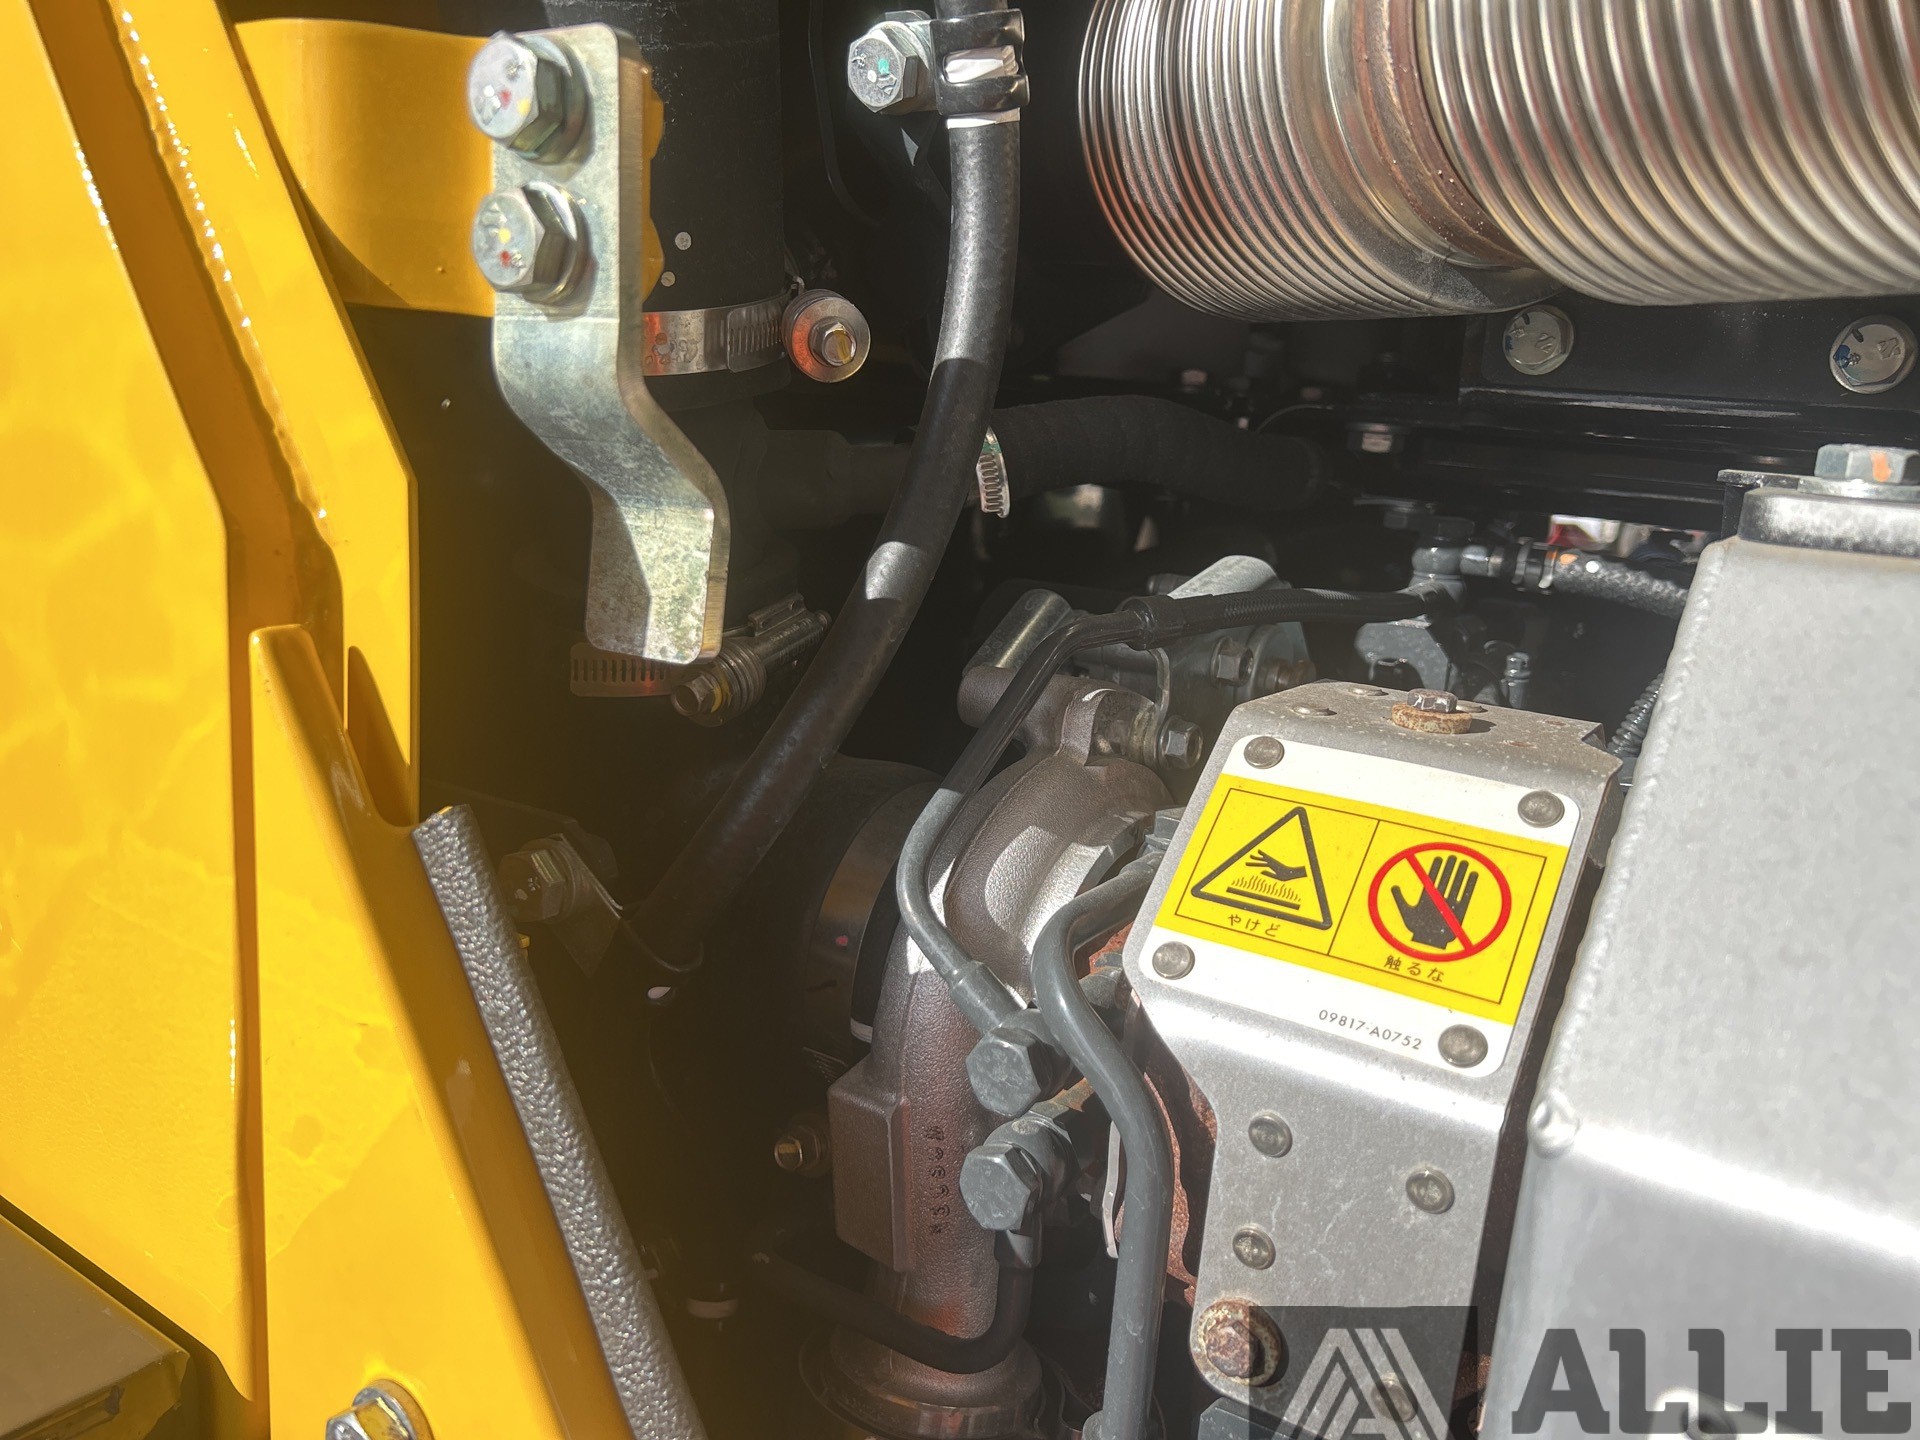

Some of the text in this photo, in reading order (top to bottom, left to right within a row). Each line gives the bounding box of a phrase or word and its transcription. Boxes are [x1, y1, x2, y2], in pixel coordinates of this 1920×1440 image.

[1228, 913, 1282, 937] やけど
[1383, 954, 1445, 983] 触るな
[1318, 1009, 1423, 1051] 09817-A0752
